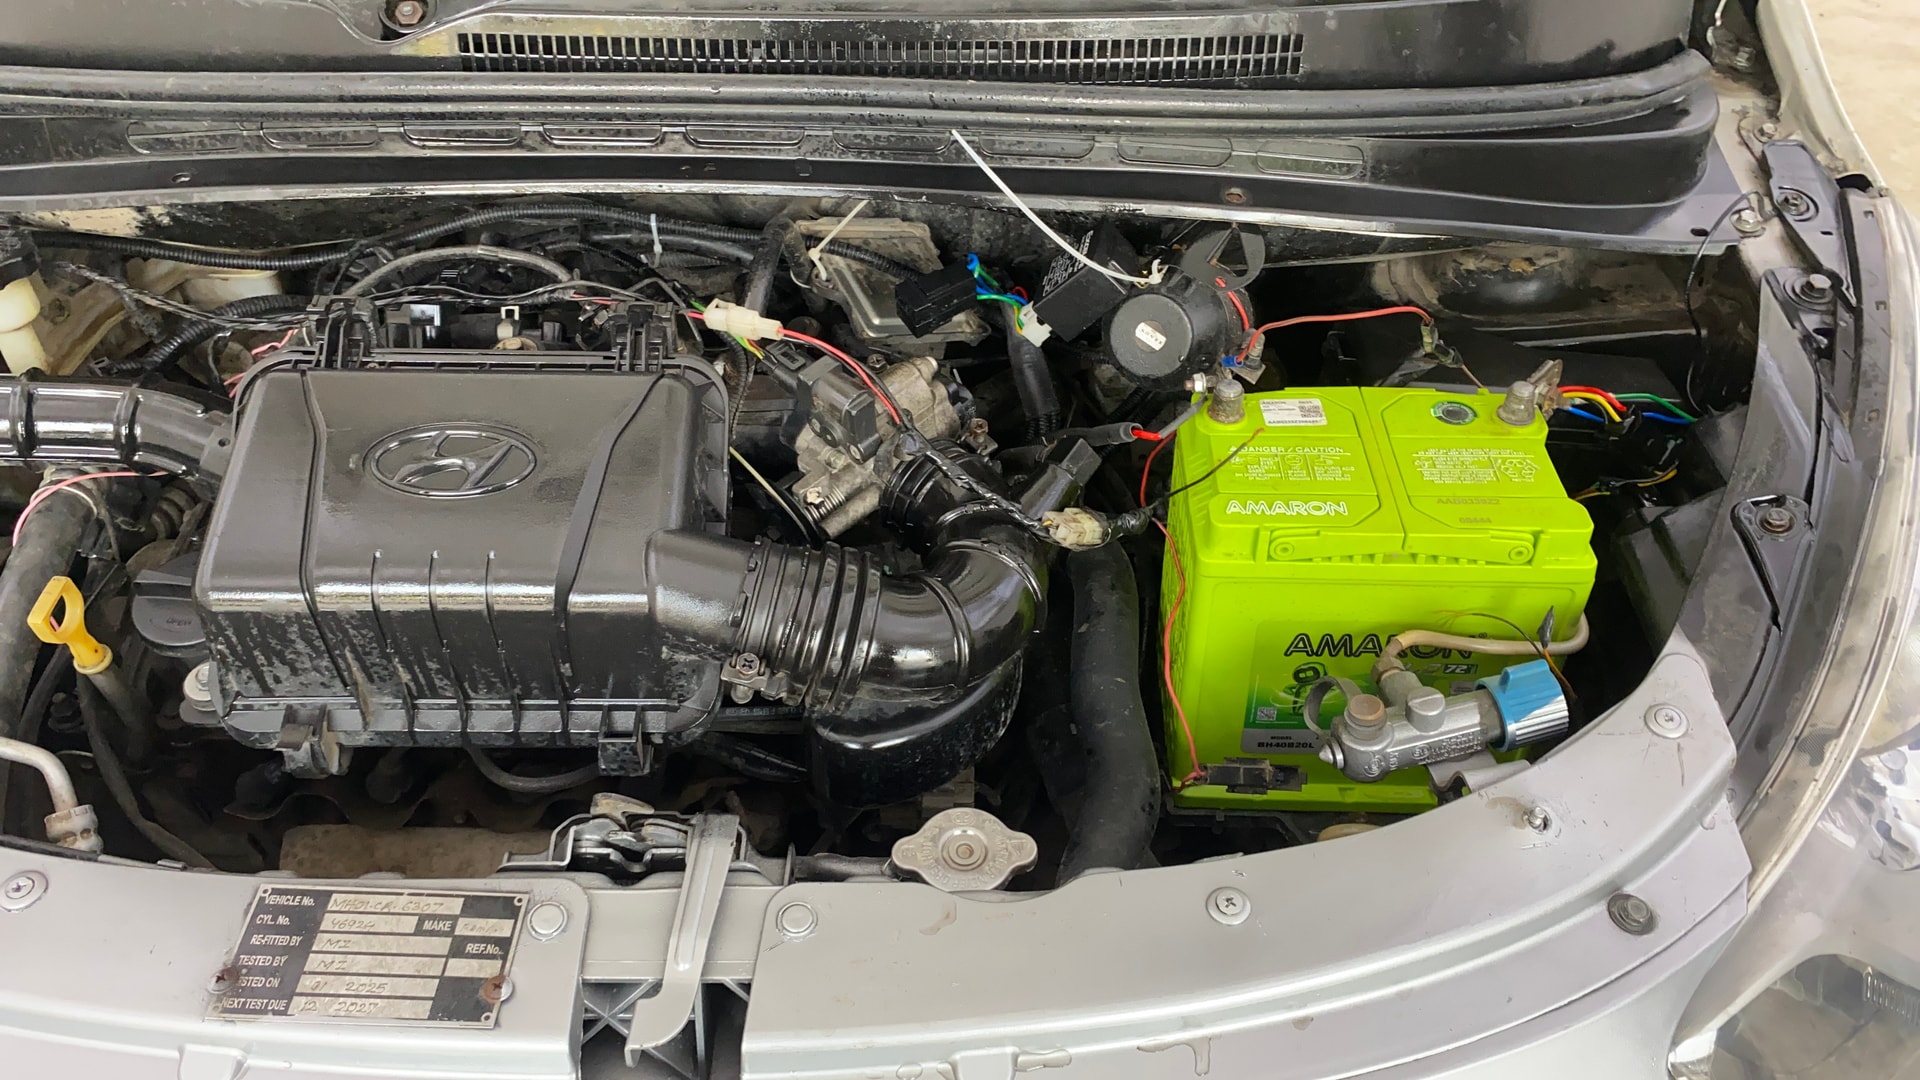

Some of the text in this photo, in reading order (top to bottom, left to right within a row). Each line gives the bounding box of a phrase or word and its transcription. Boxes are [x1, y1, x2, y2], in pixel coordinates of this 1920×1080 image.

[1226, 499, 1349, 517] AMARON
[264, 894, 316, 906] VEHICLE No.
[276, 915, 291, 925] No.
[422, 919, 453, 931] MAKE
[250, 934, 303, 946] RE-FITTED BY
[238, 955, 289, 967] TESTED BY
[238, 976, 281, 988] STED ON
[222, 997, 289, 1011] NEXT TEST DUE
